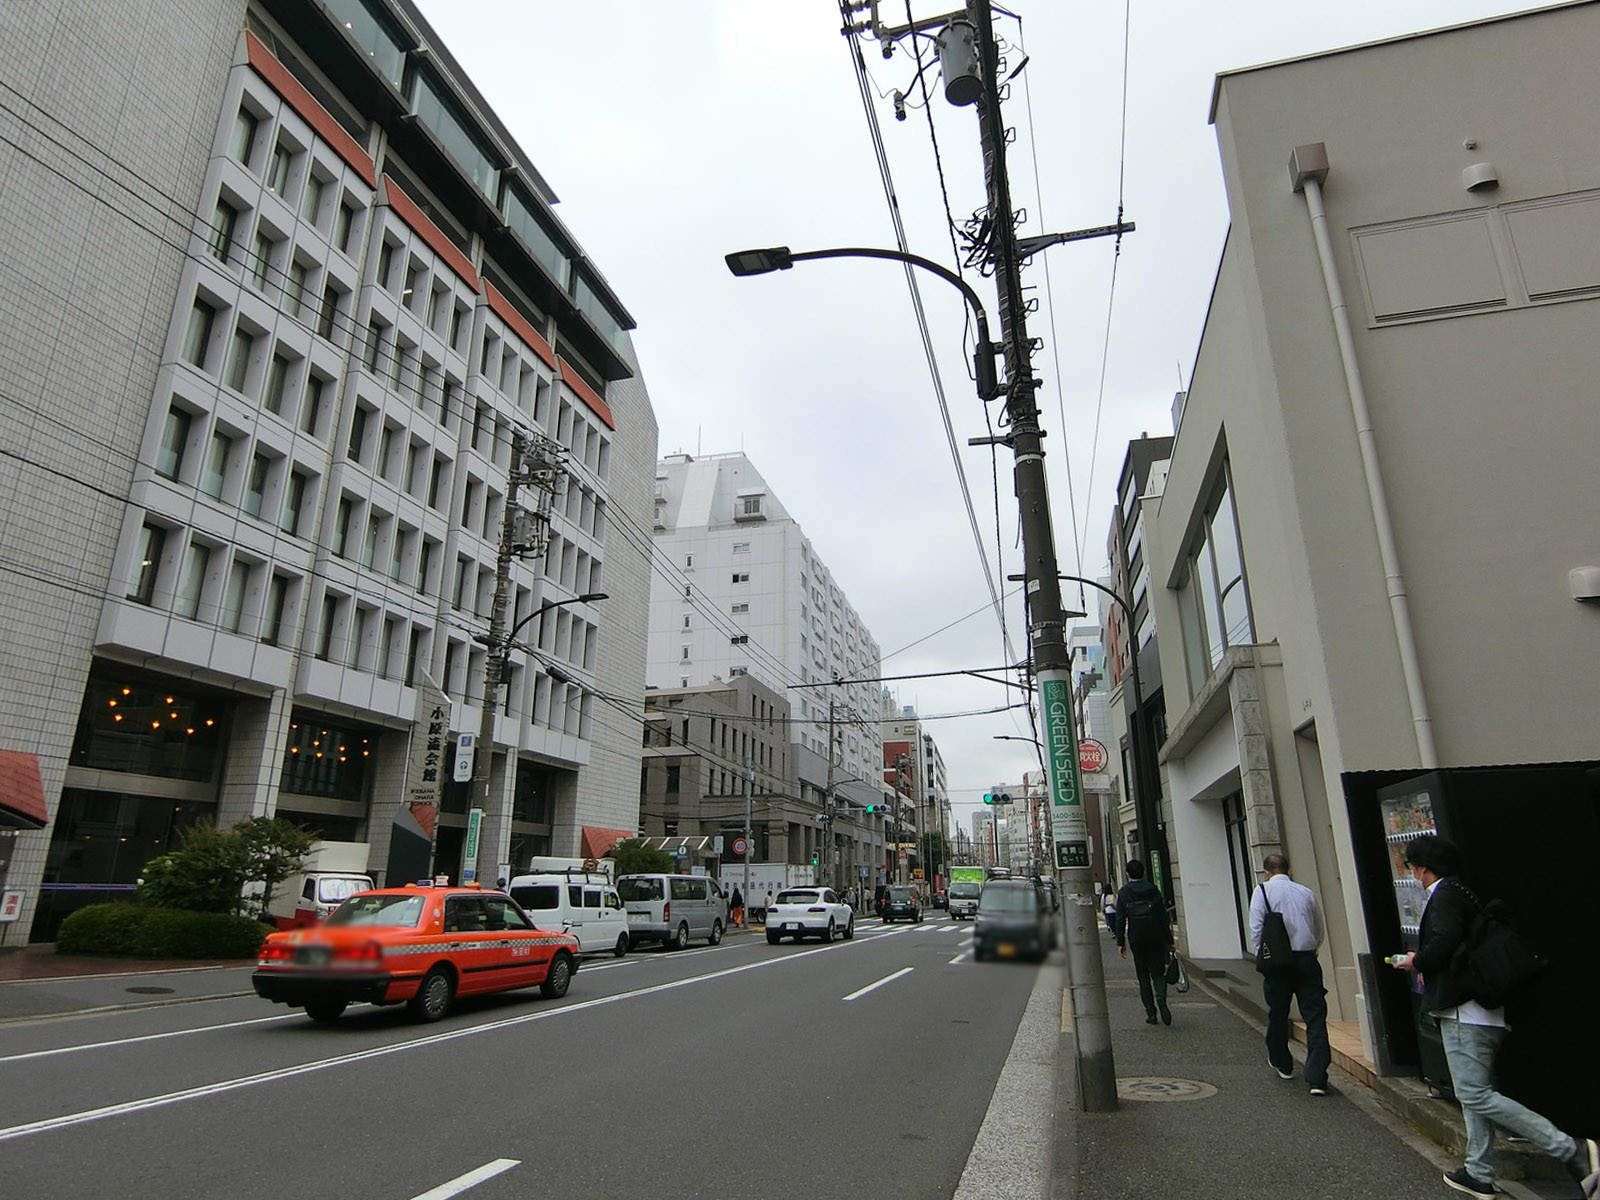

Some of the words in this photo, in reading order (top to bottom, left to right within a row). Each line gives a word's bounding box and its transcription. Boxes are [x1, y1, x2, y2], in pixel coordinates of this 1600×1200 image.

[422, 706, 444, 782] 小原流会館
[1050, 702, 1070, 756] GREEN
[1056, 760, 1075, 802] SEED
